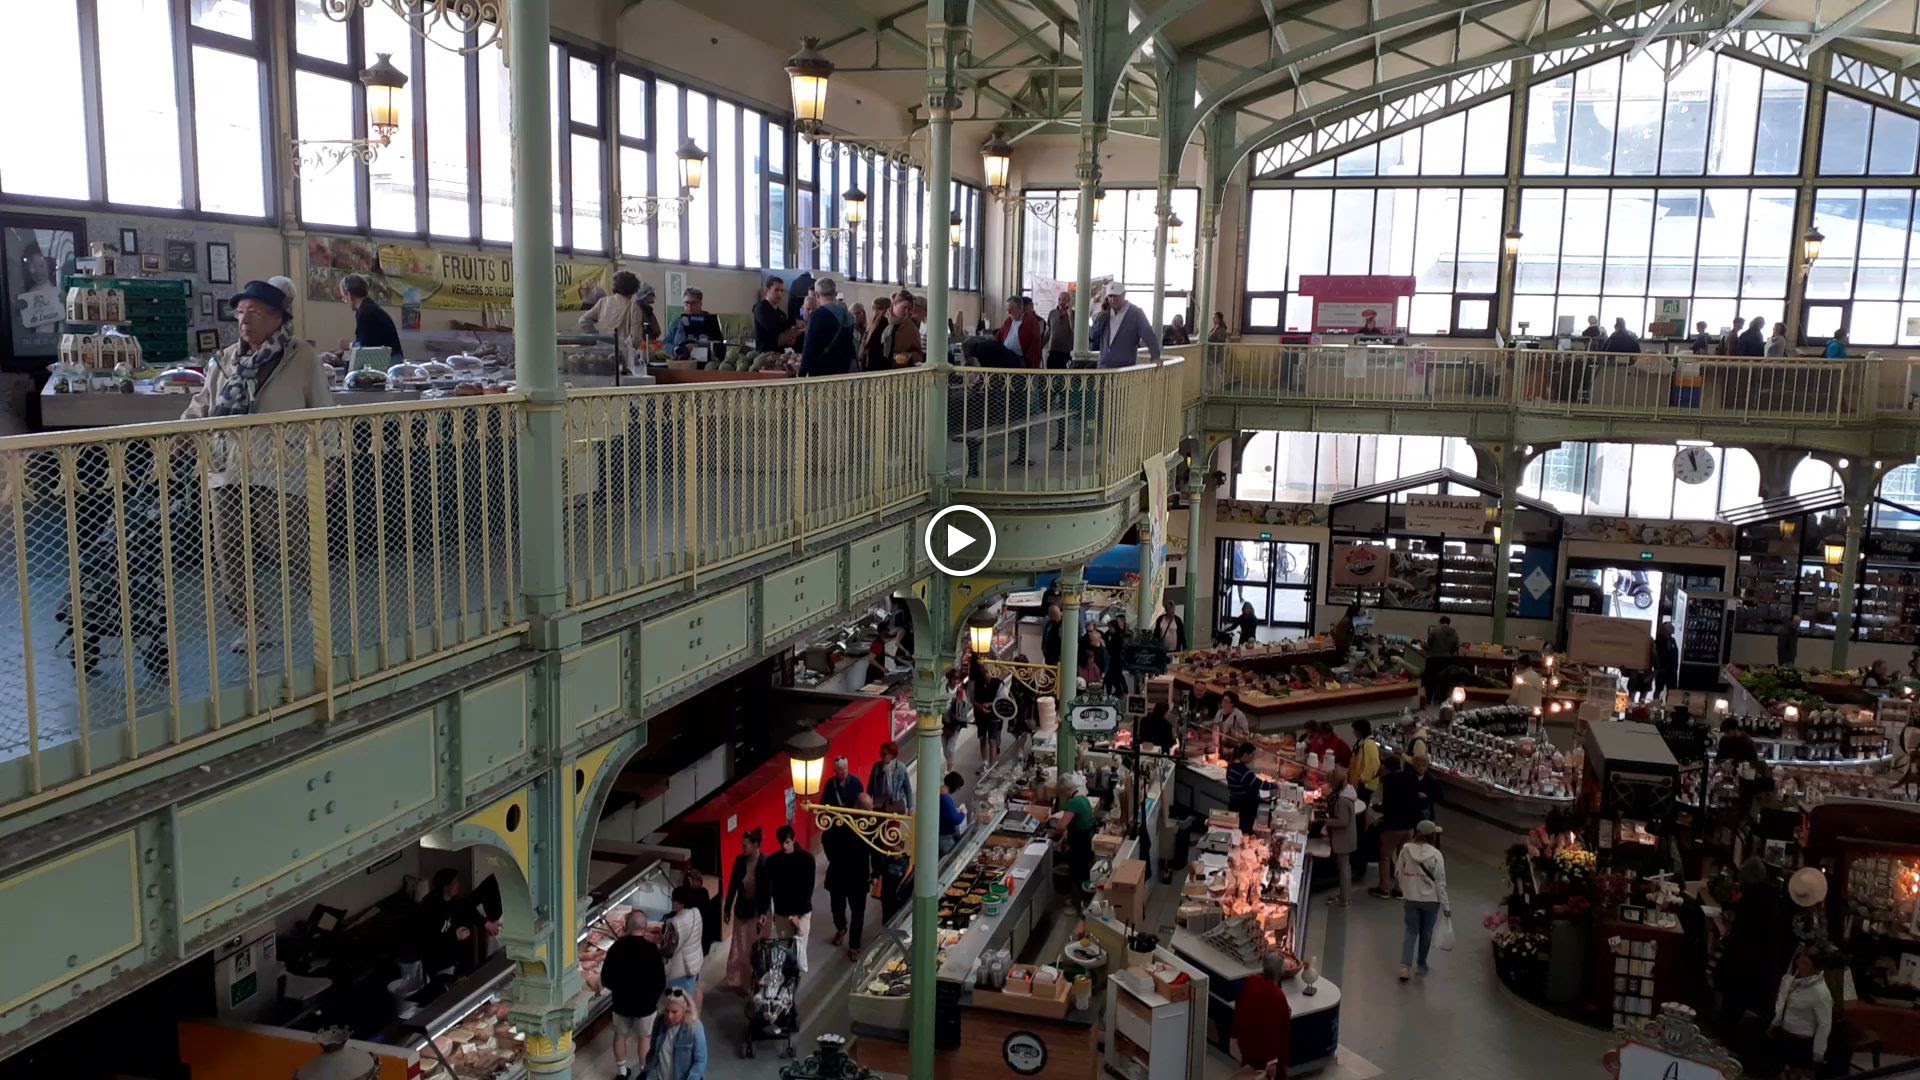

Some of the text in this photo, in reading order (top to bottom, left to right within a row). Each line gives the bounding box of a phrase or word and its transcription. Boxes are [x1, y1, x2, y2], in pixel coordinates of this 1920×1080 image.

[443, 255, 496, 281] FRUITS
[502, 260, 514, 282] D
[452, 284, 484, 296] VERGERS
[485, 286, 494, 297] DE
[495, 287, 514, 298] VEND
[1410, 499, 1482, 510] LA SABLAISE
